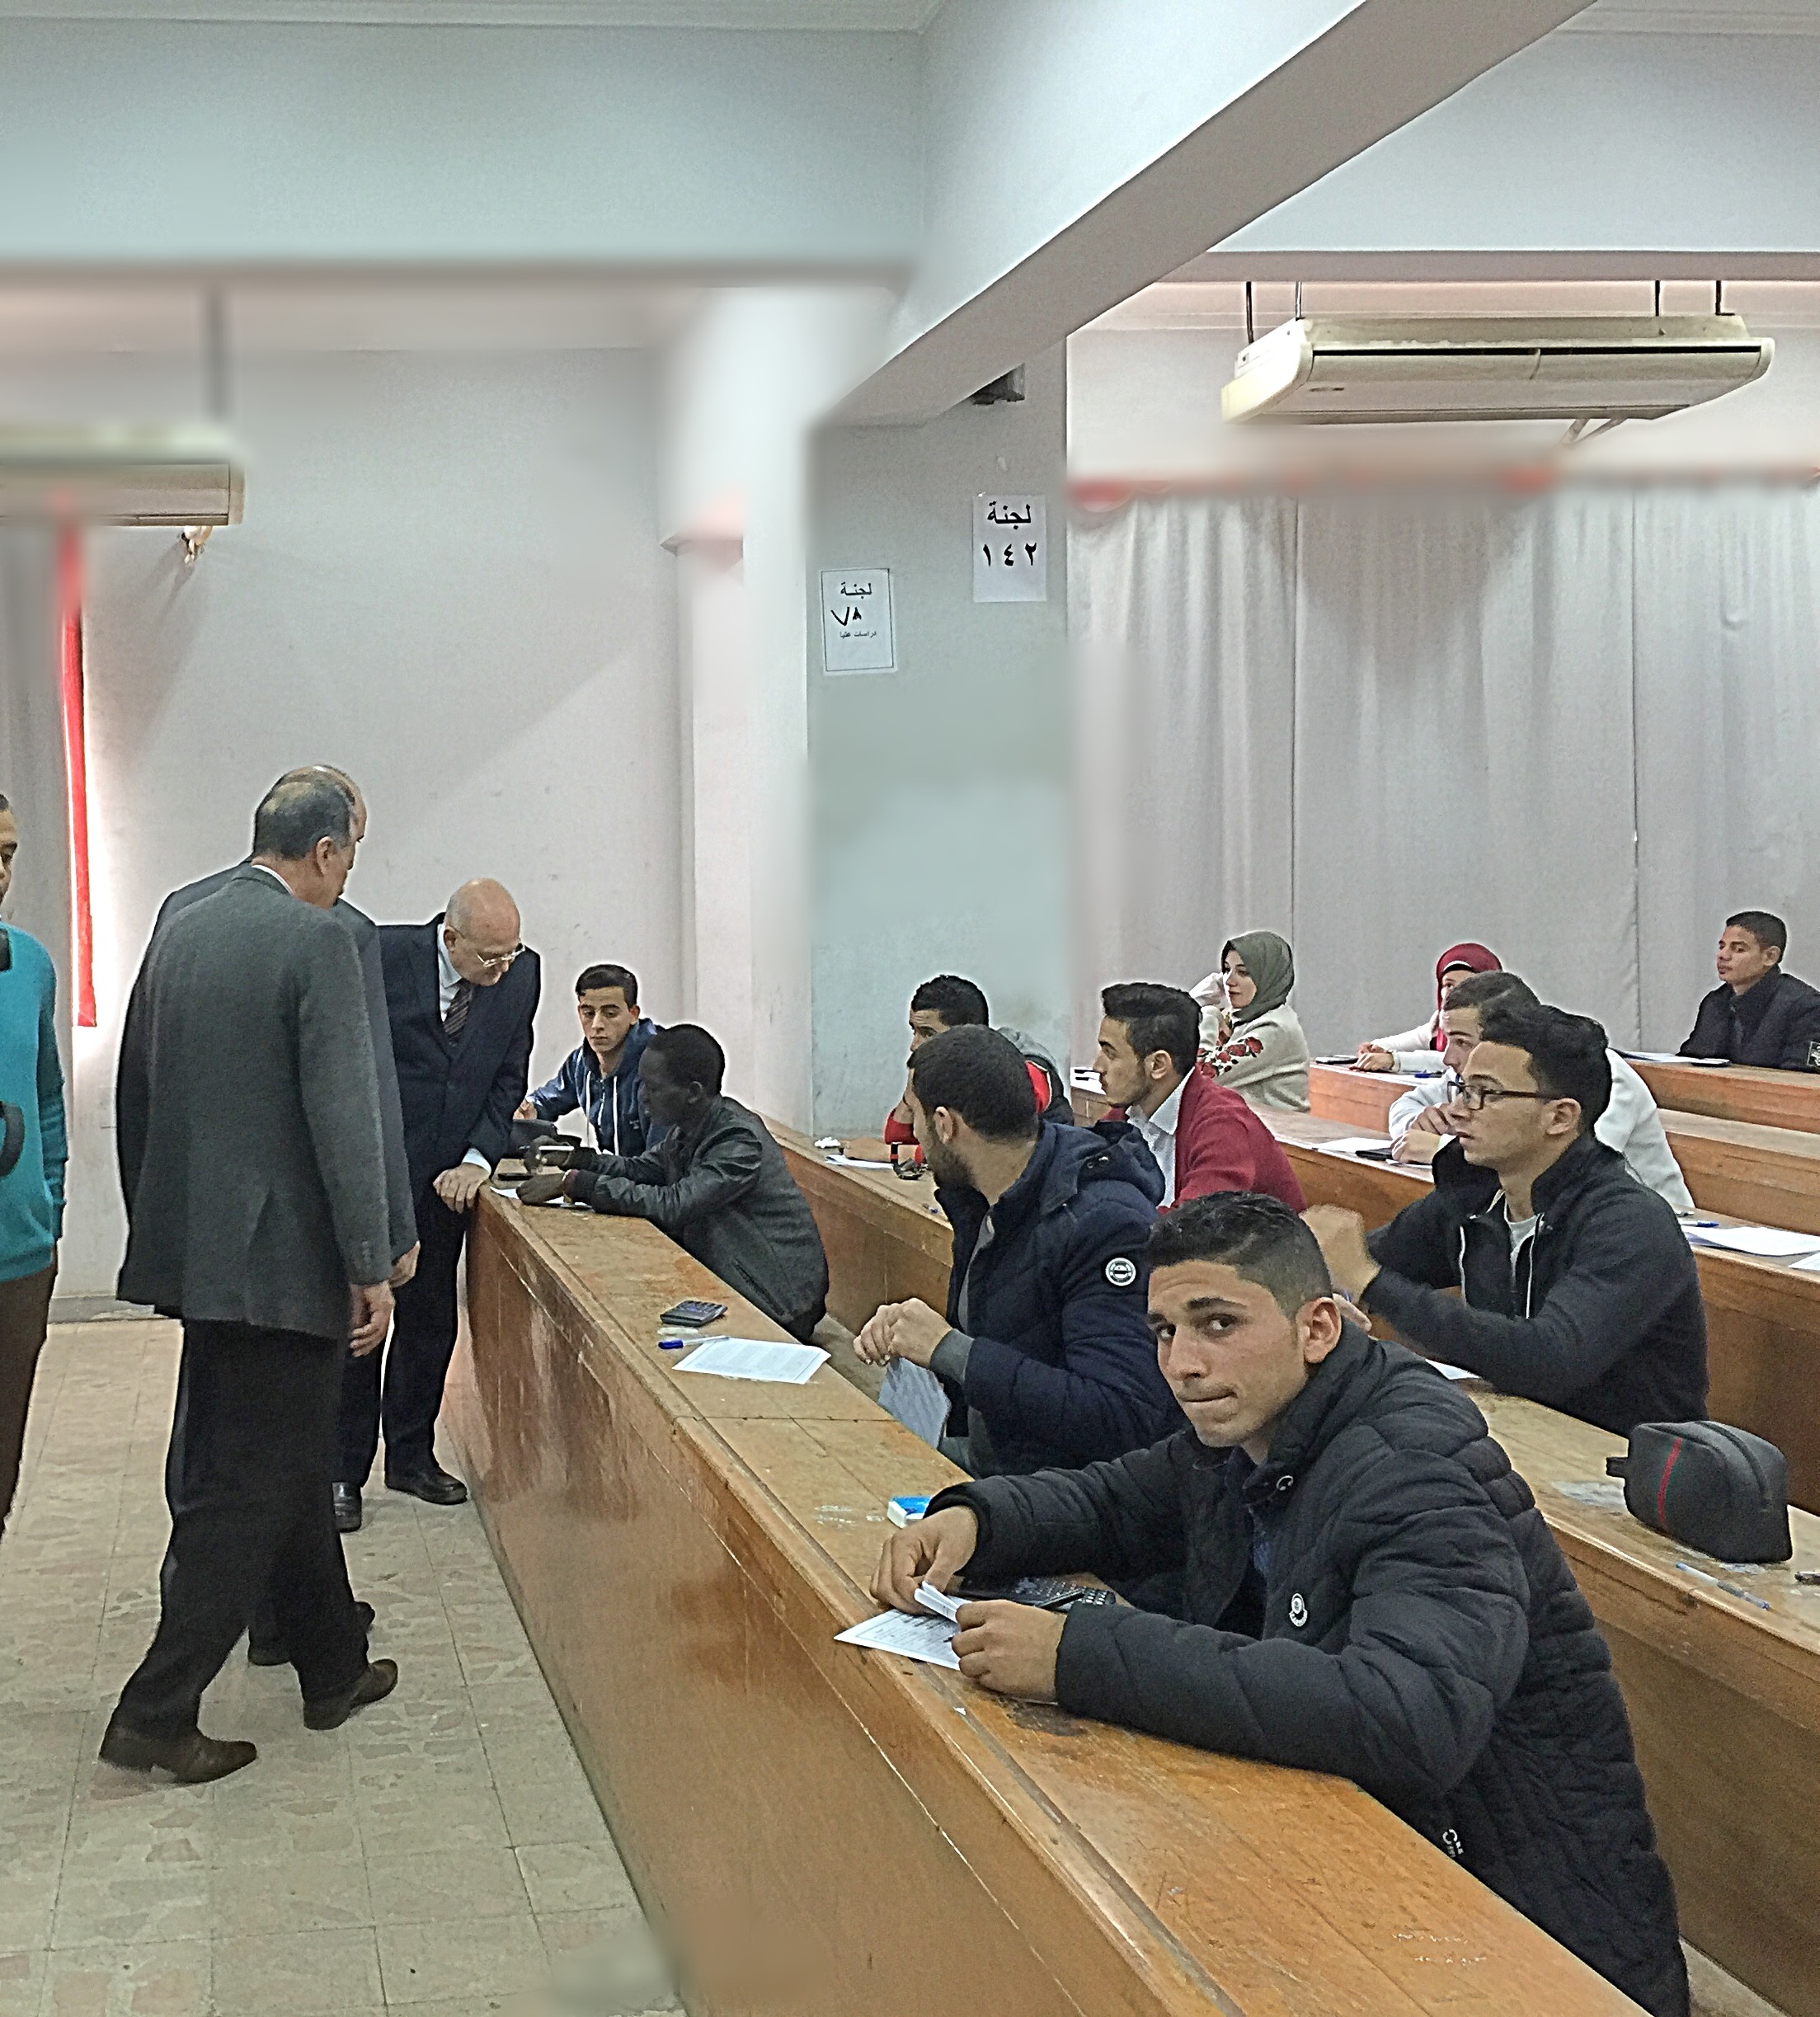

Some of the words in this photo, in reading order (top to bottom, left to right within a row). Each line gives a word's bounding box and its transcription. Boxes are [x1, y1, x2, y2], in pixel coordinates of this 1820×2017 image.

[986, 500, 1032, 530] لجنة
[982, 542, 1037, 567] ١٤٢
[839, 581, 872, 599] لجنة
